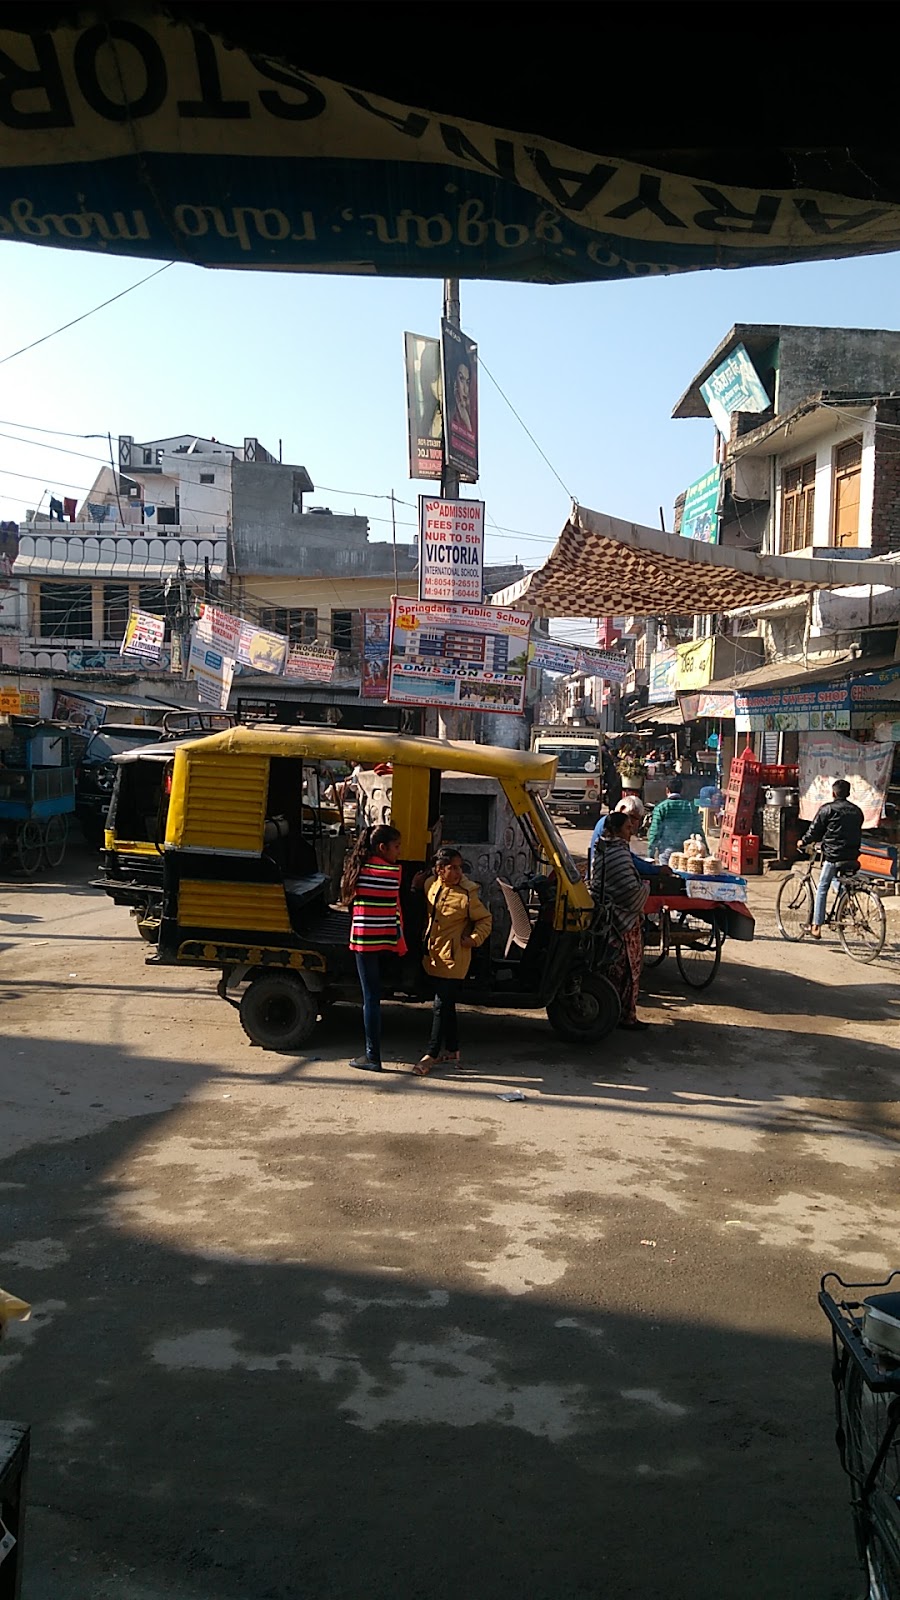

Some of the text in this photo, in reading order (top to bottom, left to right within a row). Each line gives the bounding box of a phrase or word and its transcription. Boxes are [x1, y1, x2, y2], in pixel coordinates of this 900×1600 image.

[426, 501, 481, 519] NO ADMISSION
[428, 520, 475, 531] FEES FOR
[425, 531, 481, 544] NUR TO 5th
[426, 544, 479, 565] VICTORIA
[424, 566, 479, 577] INTERNATIONAL SCHOOL
[207, 606, 241, 628] CAMBRIDGE
[398, 604, 457, 616] Springdales
[462, 608, 492, 617] Public
[496, 611, 531, 628] School
[296, 644, 337, 656] WOODBURY
[311, 652, 335, 660] SCHOOL
[393, 664, 524, 682] ADMISSION OPEN
[736, 696, 782, 708] CHARNJIT
[782, 693, 816, 706] SWEET
[818, 690, 848, 703] SHOP
